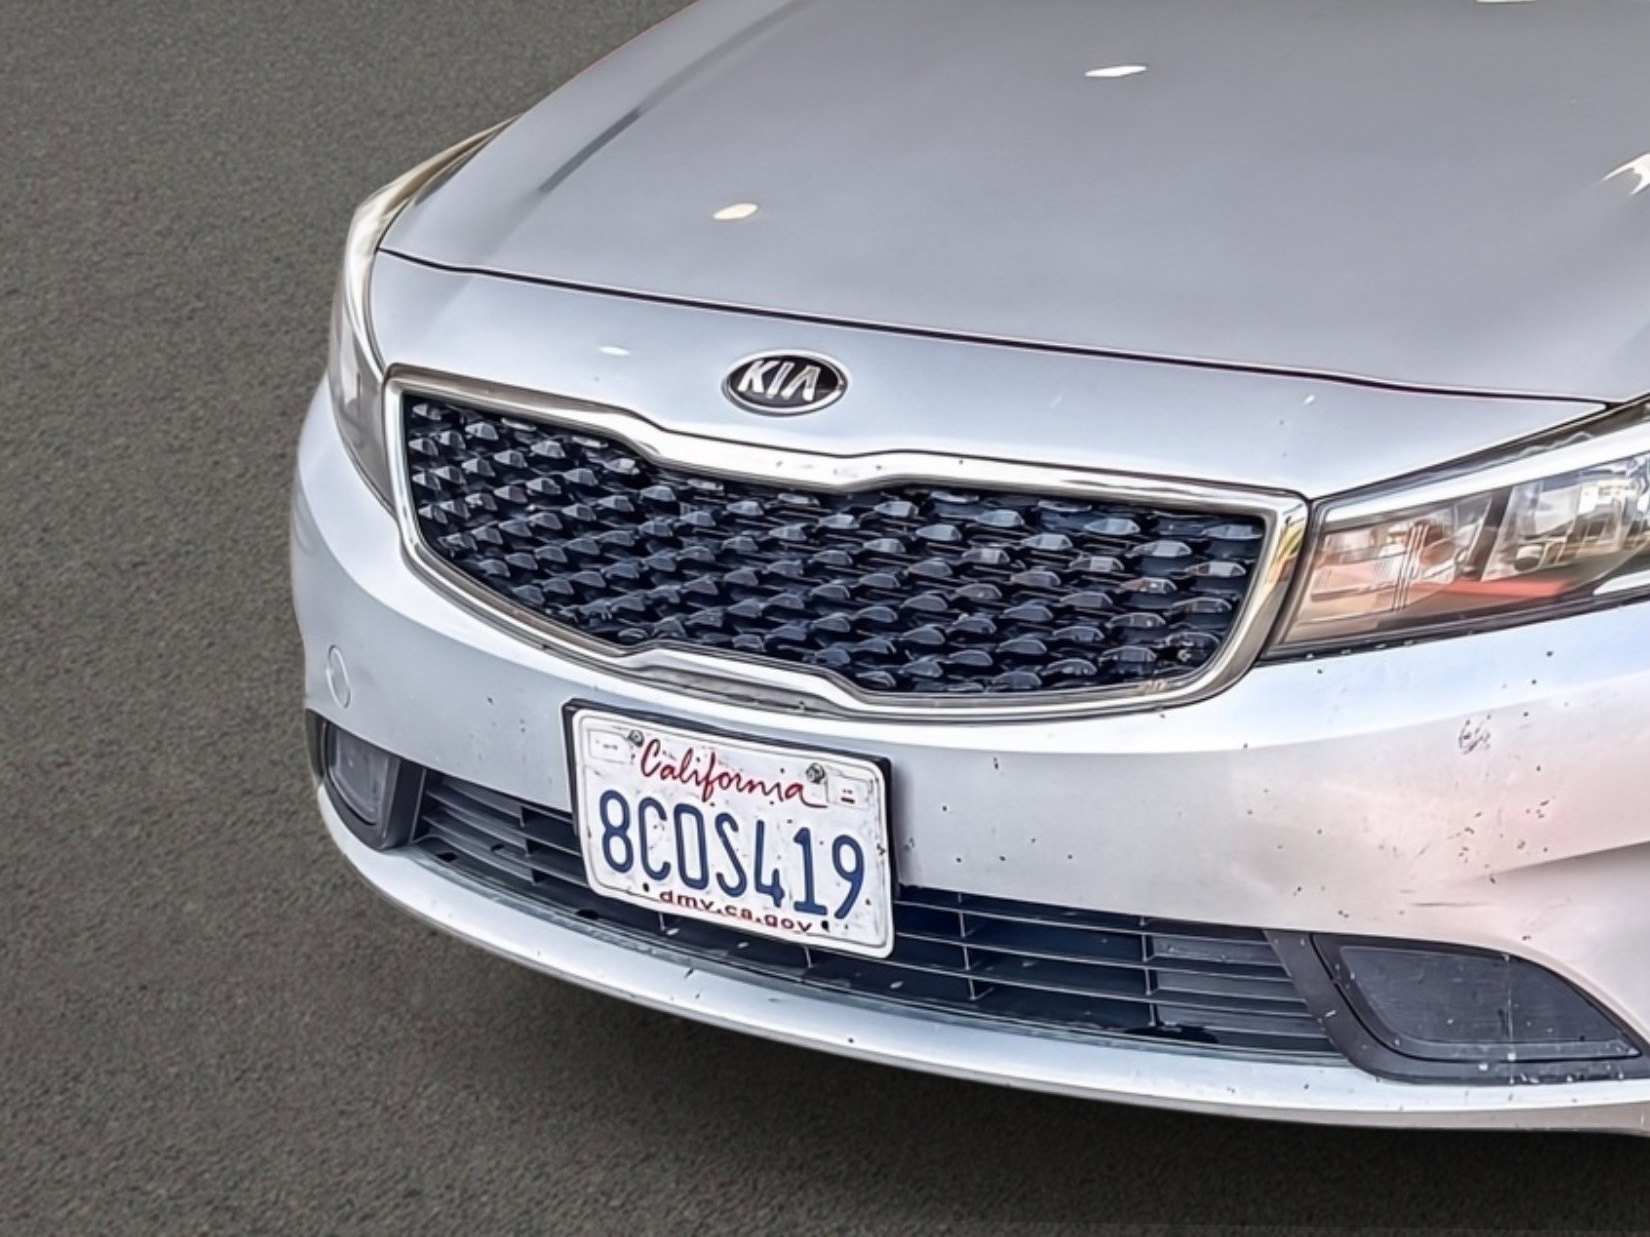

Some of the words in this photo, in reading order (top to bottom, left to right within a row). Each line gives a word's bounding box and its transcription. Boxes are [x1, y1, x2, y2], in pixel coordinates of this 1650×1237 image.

[738, 360, 821, 401] KIA
[639, 738, 828, 808] California
[659, 889, 812, 933] dmv.ca.gov
